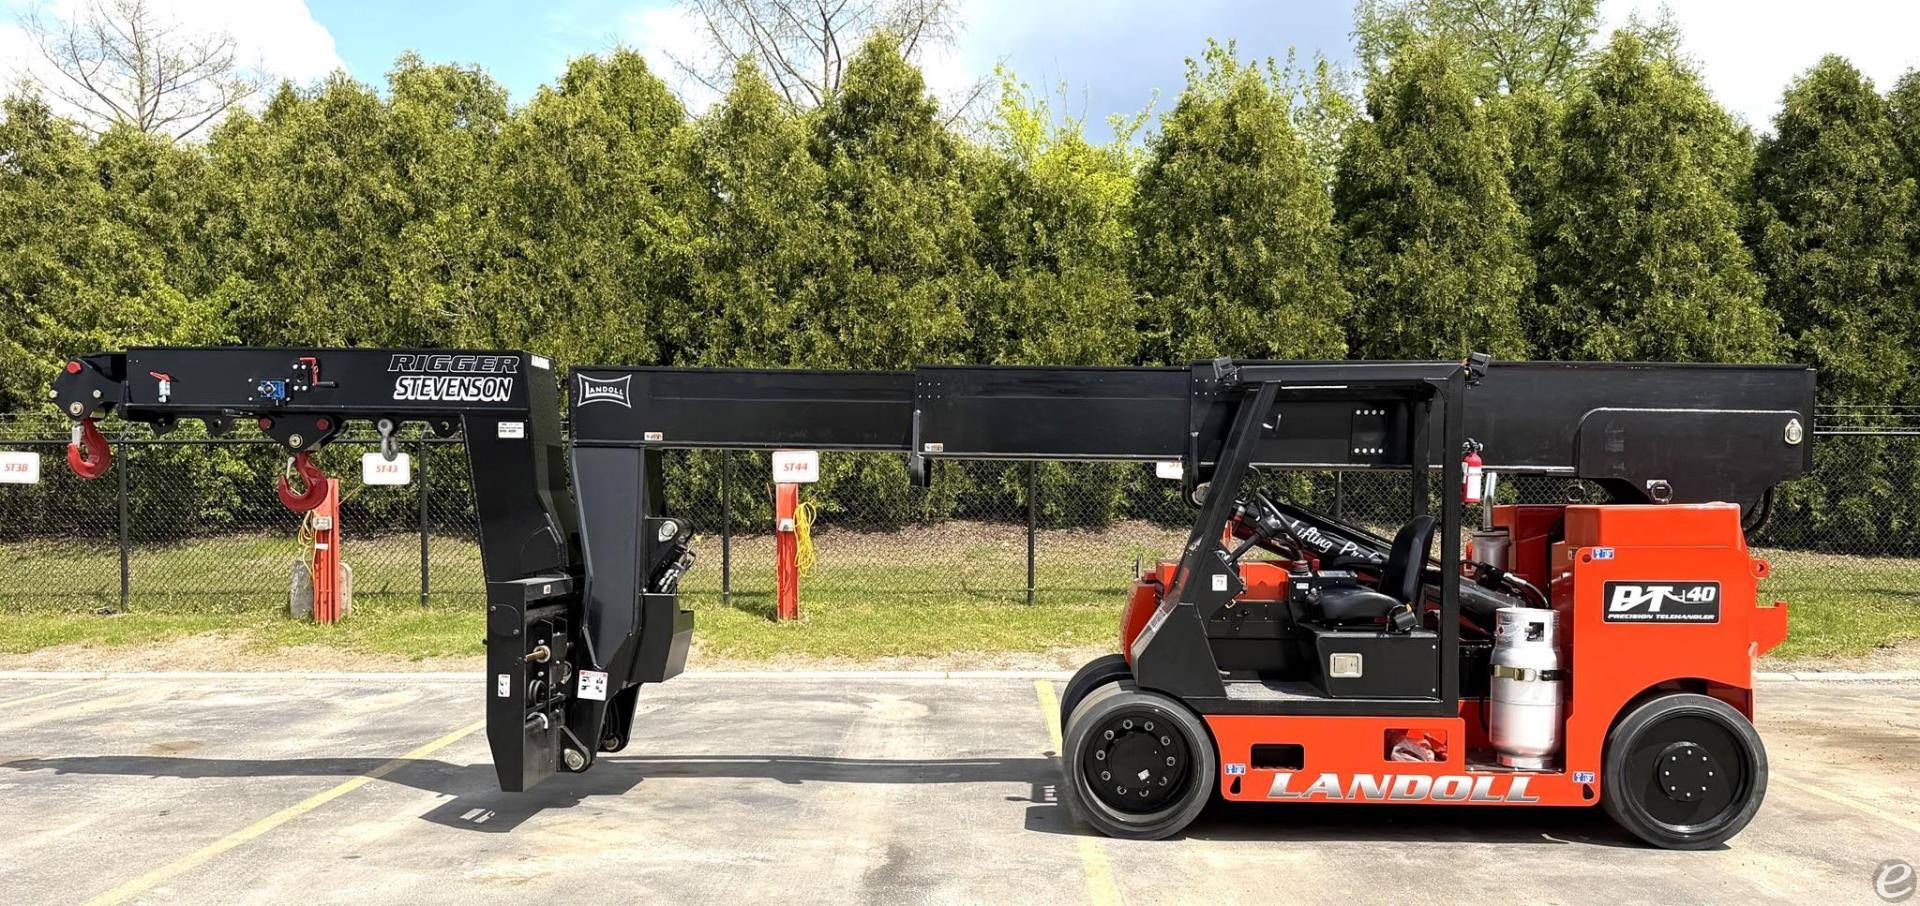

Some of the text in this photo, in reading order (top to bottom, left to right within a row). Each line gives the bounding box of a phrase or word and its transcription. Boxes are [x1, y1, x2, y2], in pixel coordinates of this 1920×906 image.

[387, 354, 520, 374] RIGGER
[393, 375, 513, 402] STEVENSON
[585, 381, 625, 400] LANDOLL
[375, 464, 398, 473] ST43
[783, 462, 808, 471] ST44
[1686, 586, 1716, 602] 40
[1268, 772, 1540, 802] LANDOLL
